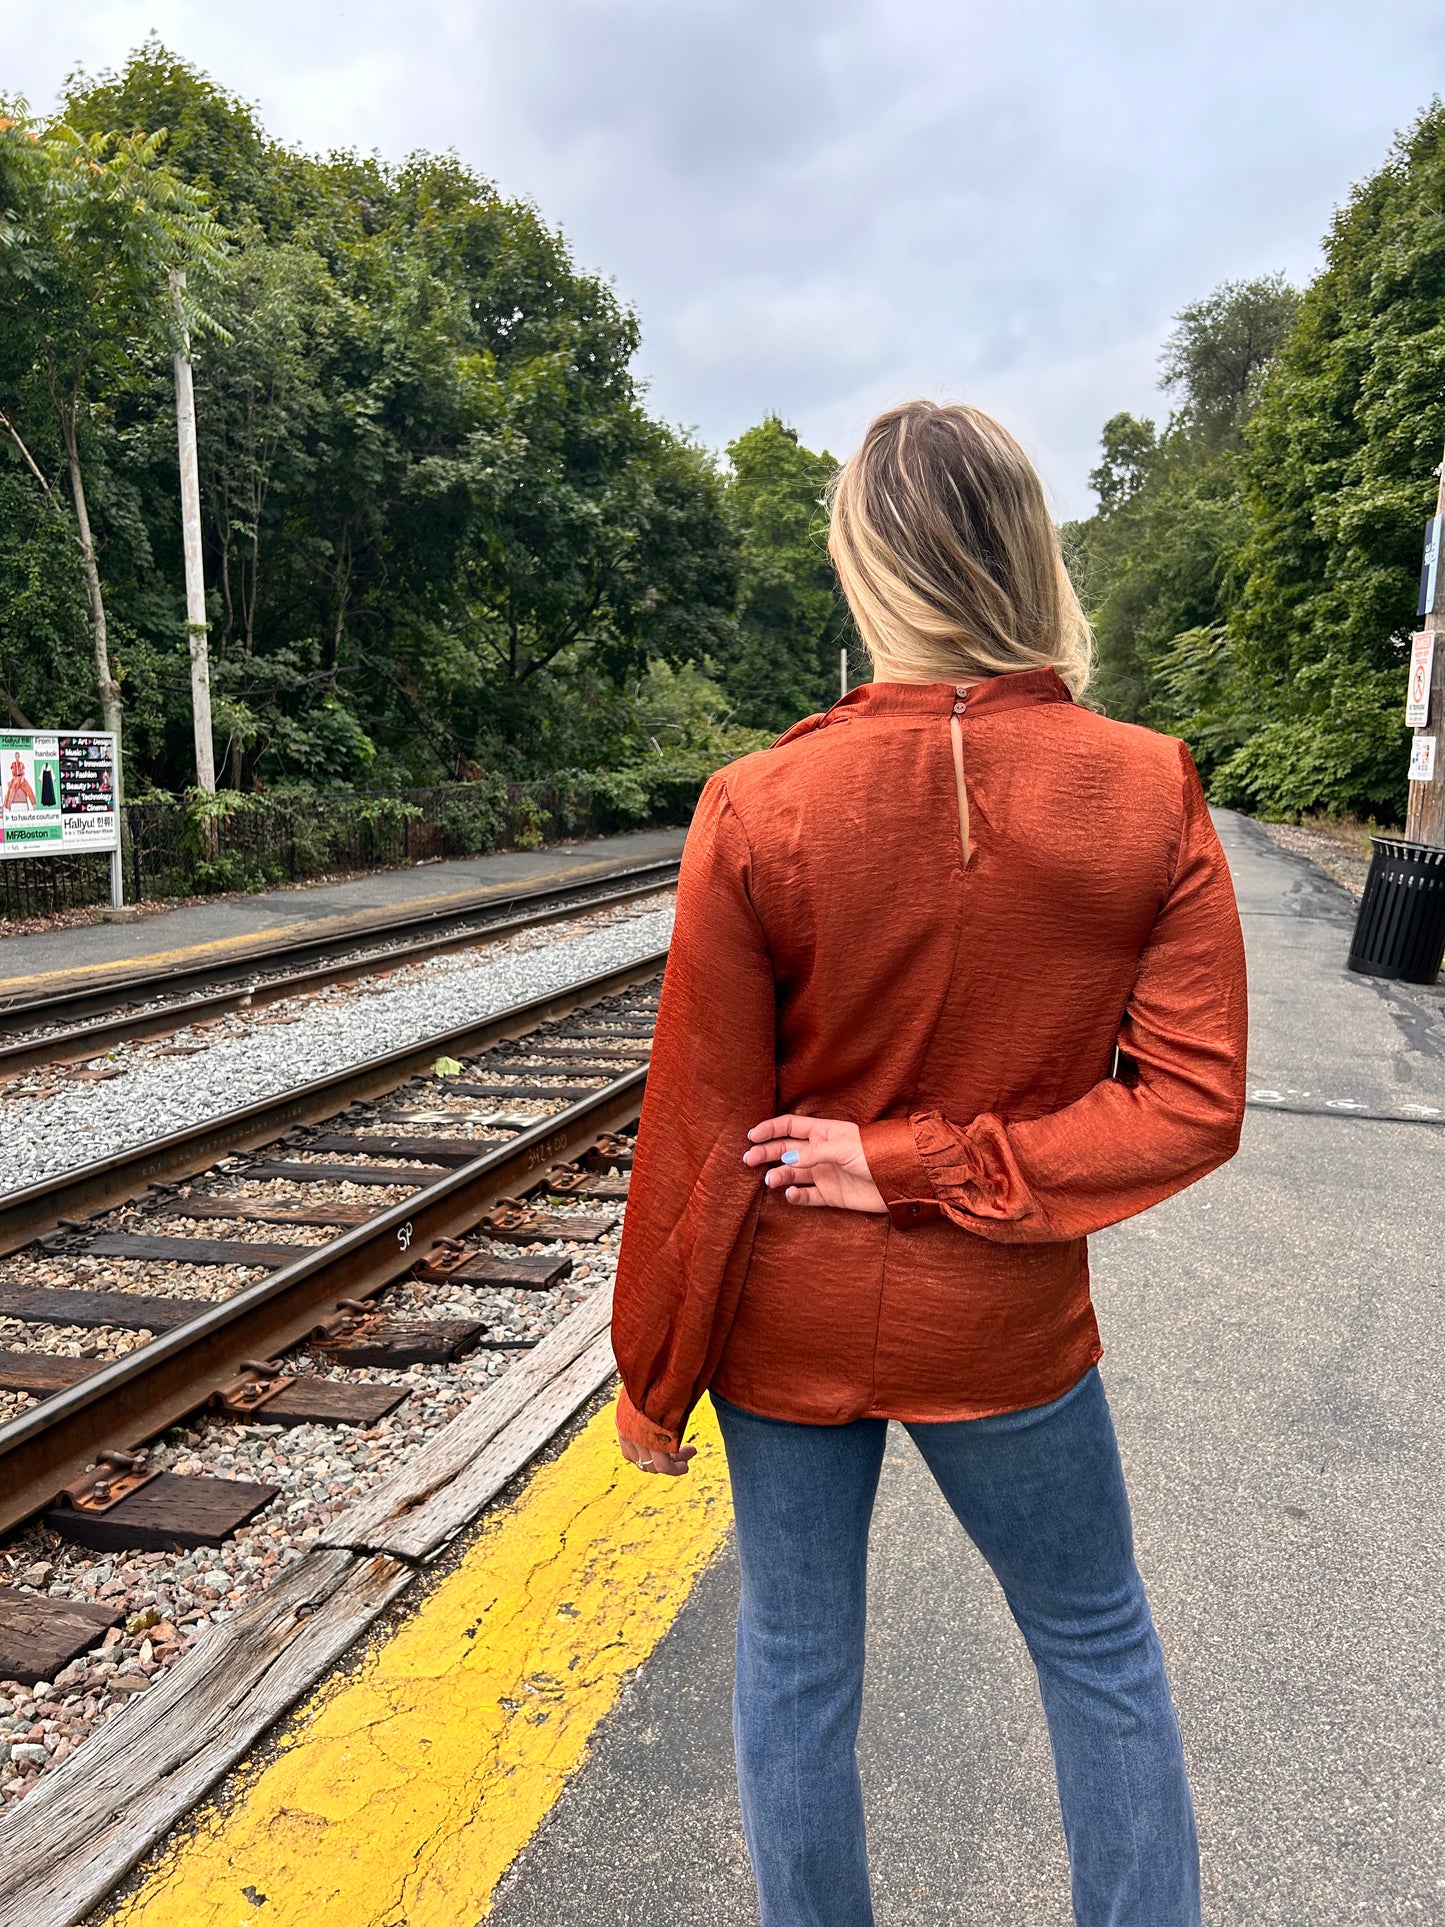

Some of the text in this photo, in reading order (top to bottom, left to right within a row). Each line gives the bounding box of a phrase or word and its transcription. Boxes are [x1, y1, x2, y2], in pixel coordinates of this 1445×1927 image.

[93, 738, 112, 746] Design
[66, 782, 86, 791] Beauty
[63, 817, 95, 831] Hallyu!
[396, 1221, 413, 1252] SP
